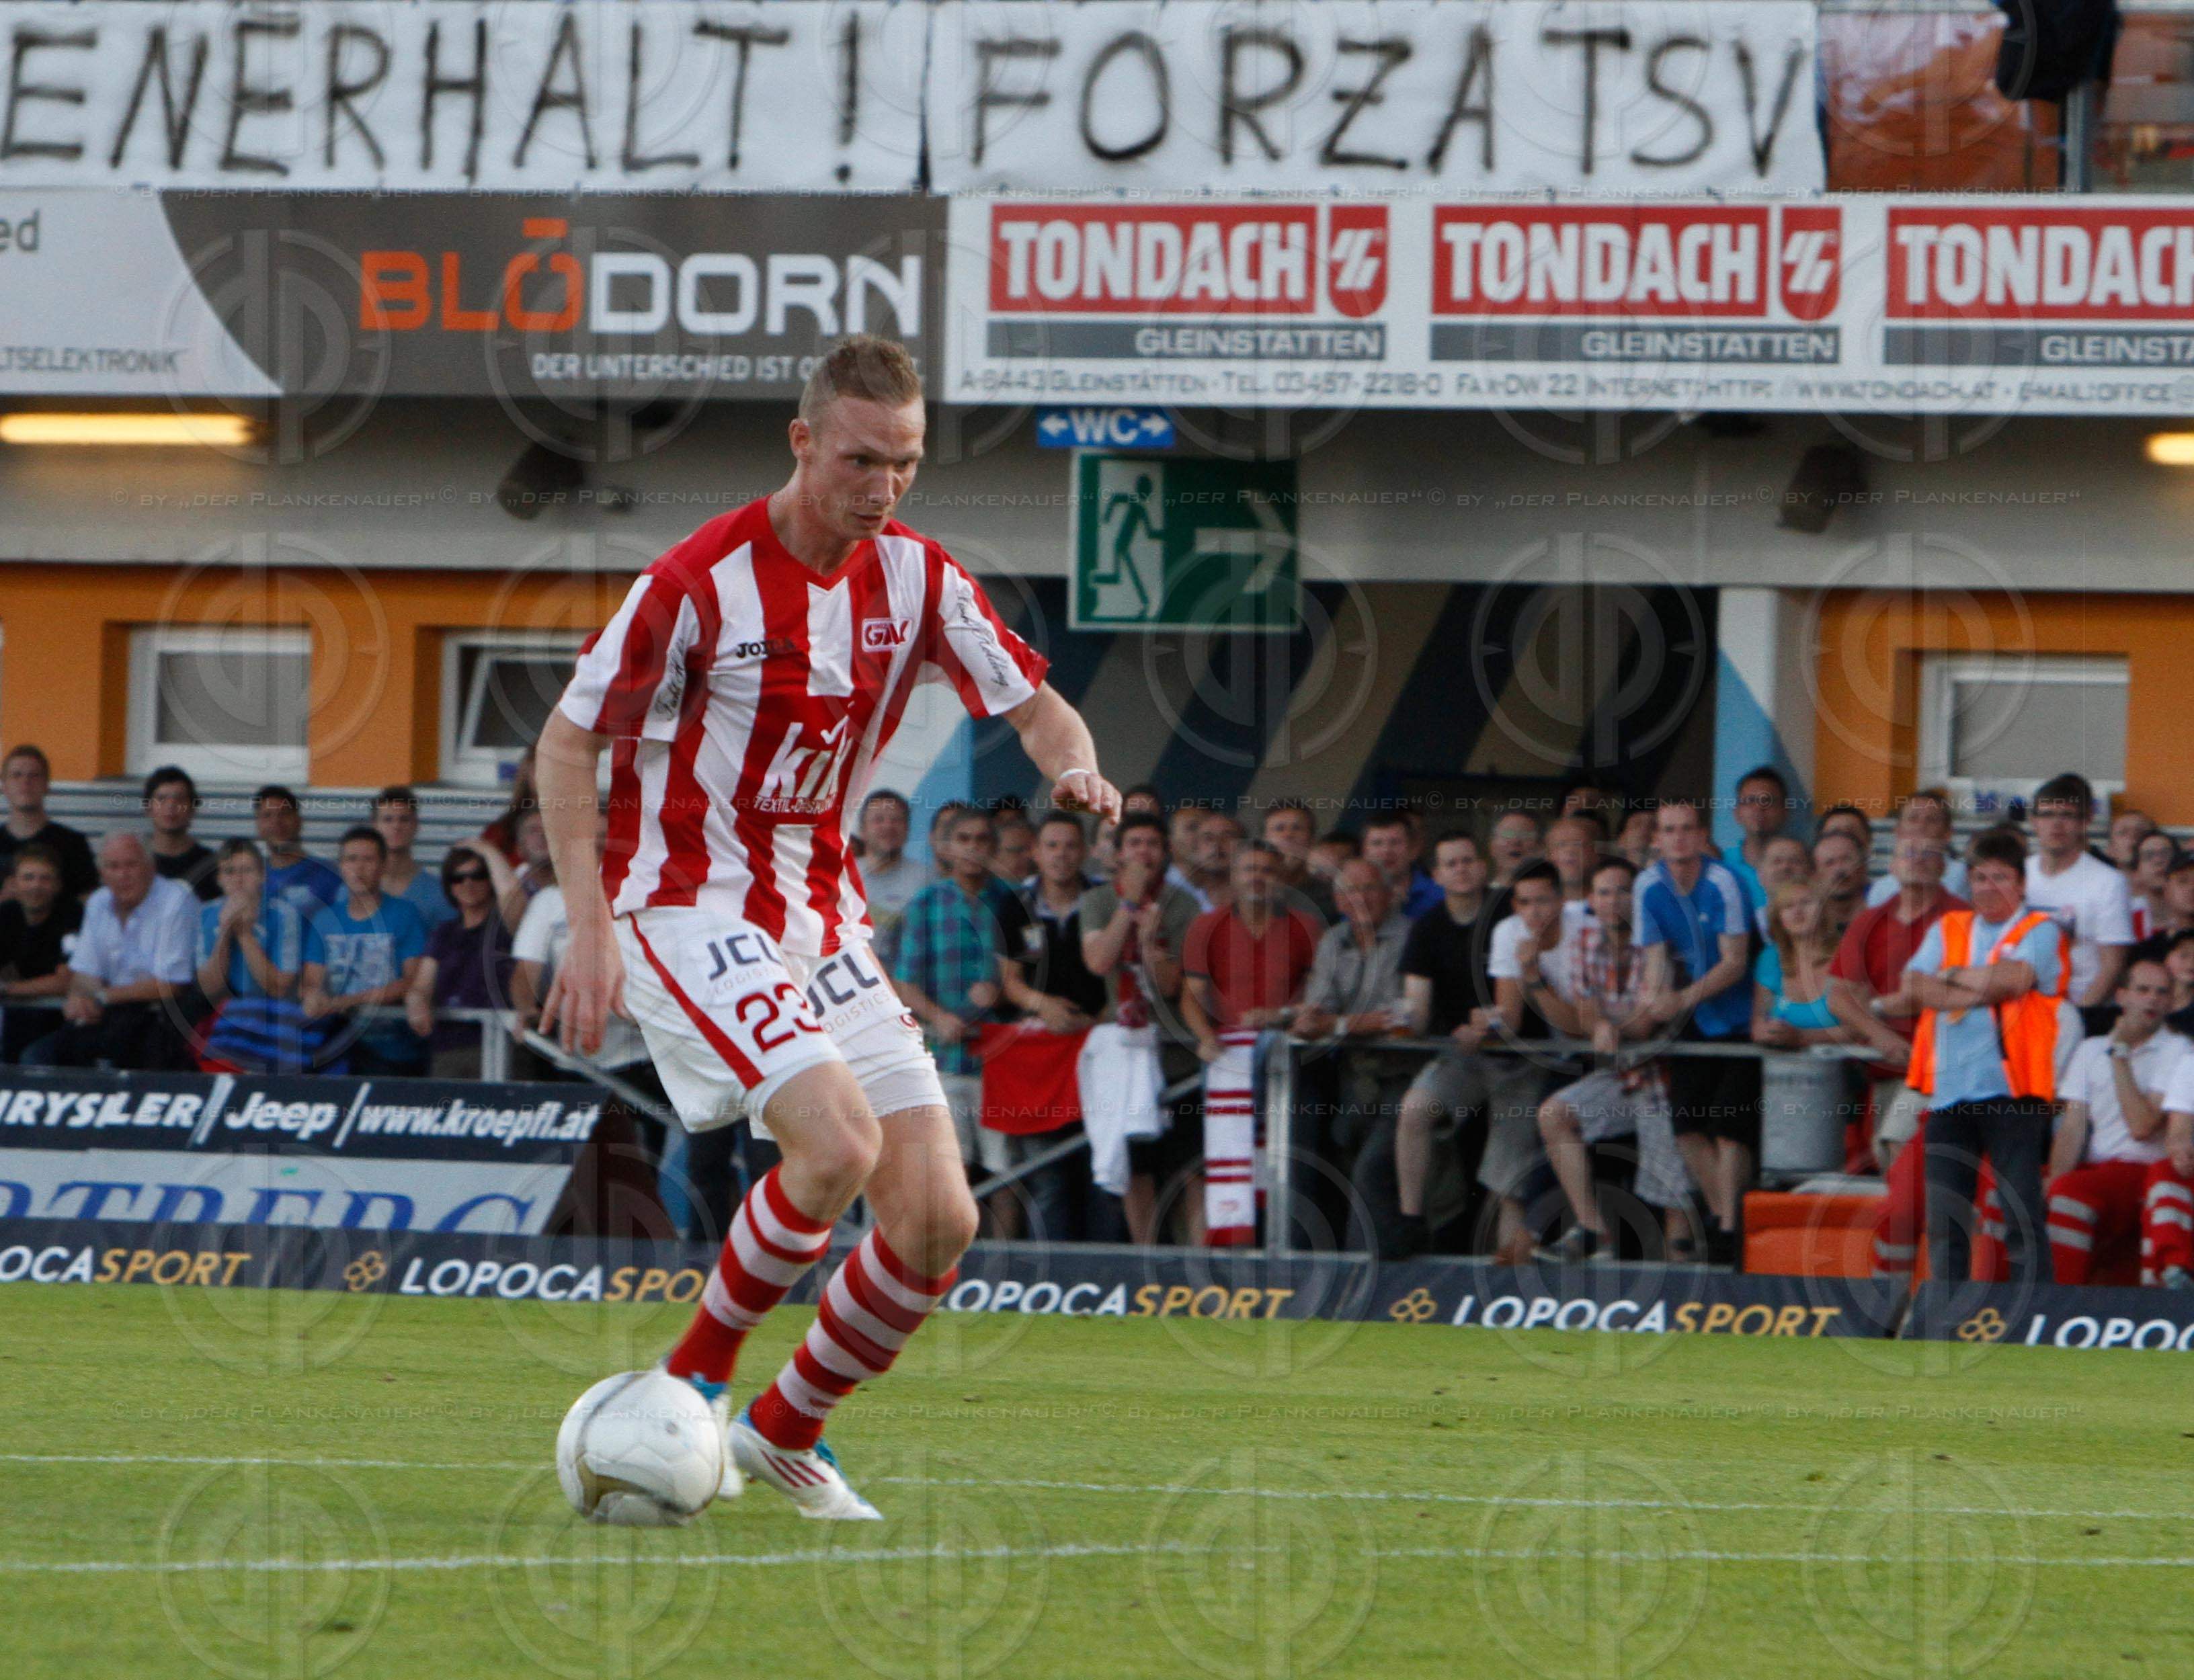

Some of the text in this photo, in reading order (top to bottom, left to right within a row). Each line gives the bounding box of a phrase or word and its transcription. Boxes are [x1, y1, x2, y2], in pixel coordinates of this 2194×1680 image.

[973, 24, 1808, 177] FORZA TSV
[998, 220, 1309, 301] TONDACH
[1441, 220, 1758, 304] TONDACH
[532, 353, 582, 380] DER
[585, 353, 750, 382] UNTERSCHIED
[756, 355, 793, 382] IST
[1548, 372, 1578, 396] 22
[1070, 409, 1141, 444] WC
[807, 953, 880, 1019] JCL
[821, 990, 891, 1034] OGISTICS
[735, 982, 824, 1054] 23
[224, 1091, 335, 1141] Jeep
[357, 1099, 599, 1147] www.kroepfl.at
